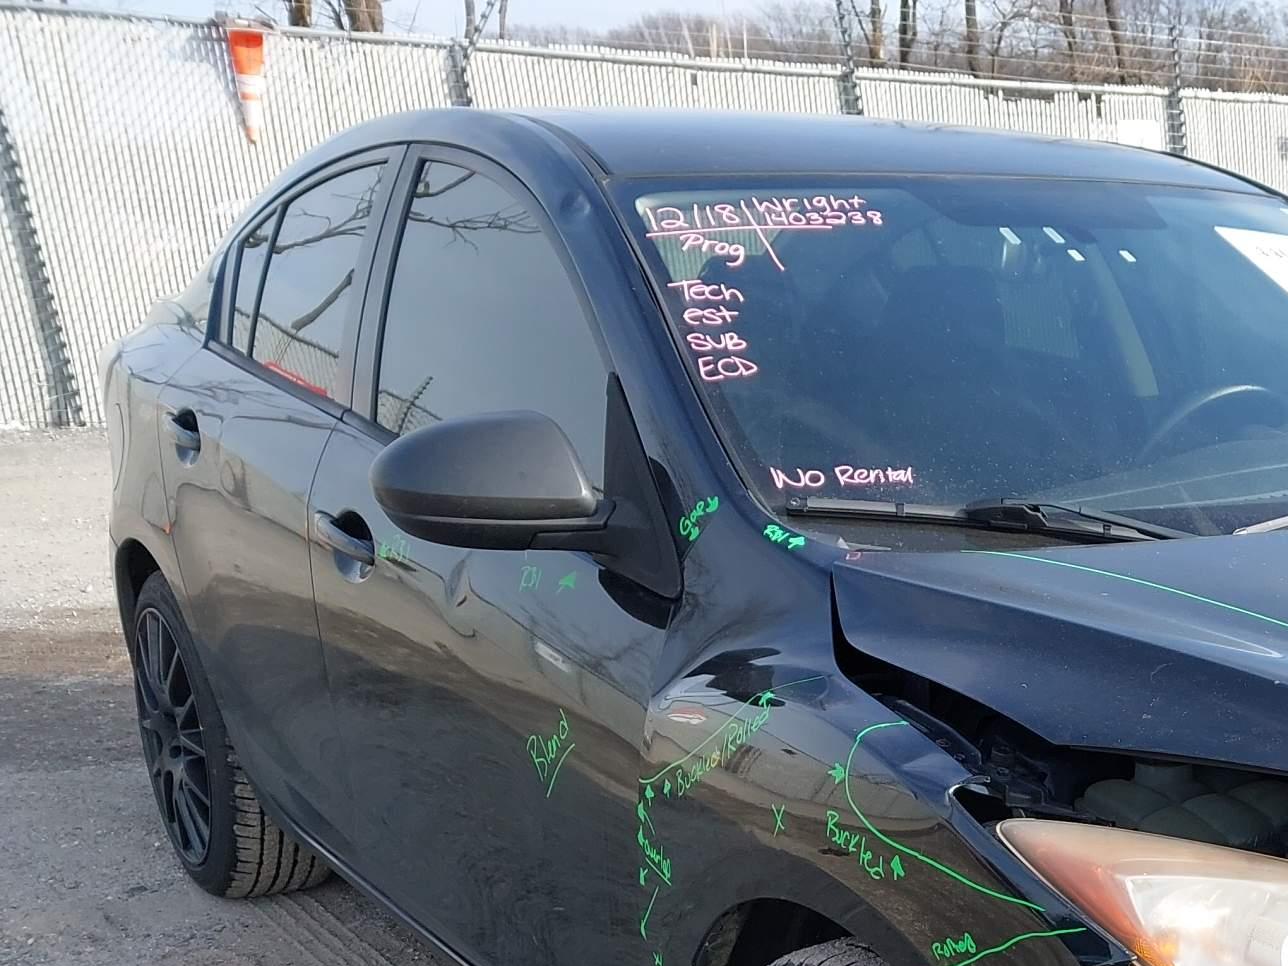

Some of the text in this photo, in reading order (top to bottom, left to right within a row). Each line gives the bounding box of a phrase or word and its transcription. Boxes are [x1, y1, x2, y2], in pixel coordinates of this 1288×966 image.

[752, 195, 866, 216] Wright
[765, 211, 883, 226] 1403238
[679, 233, 745, 266] Prog
[667, 279, 744, 302] Tech
[683, 305, 739, 325] est
[834, 465, 913, 486] Rental
[526, 708, 569, 782] Blend
[826, 810, 885, 879] Buckled
